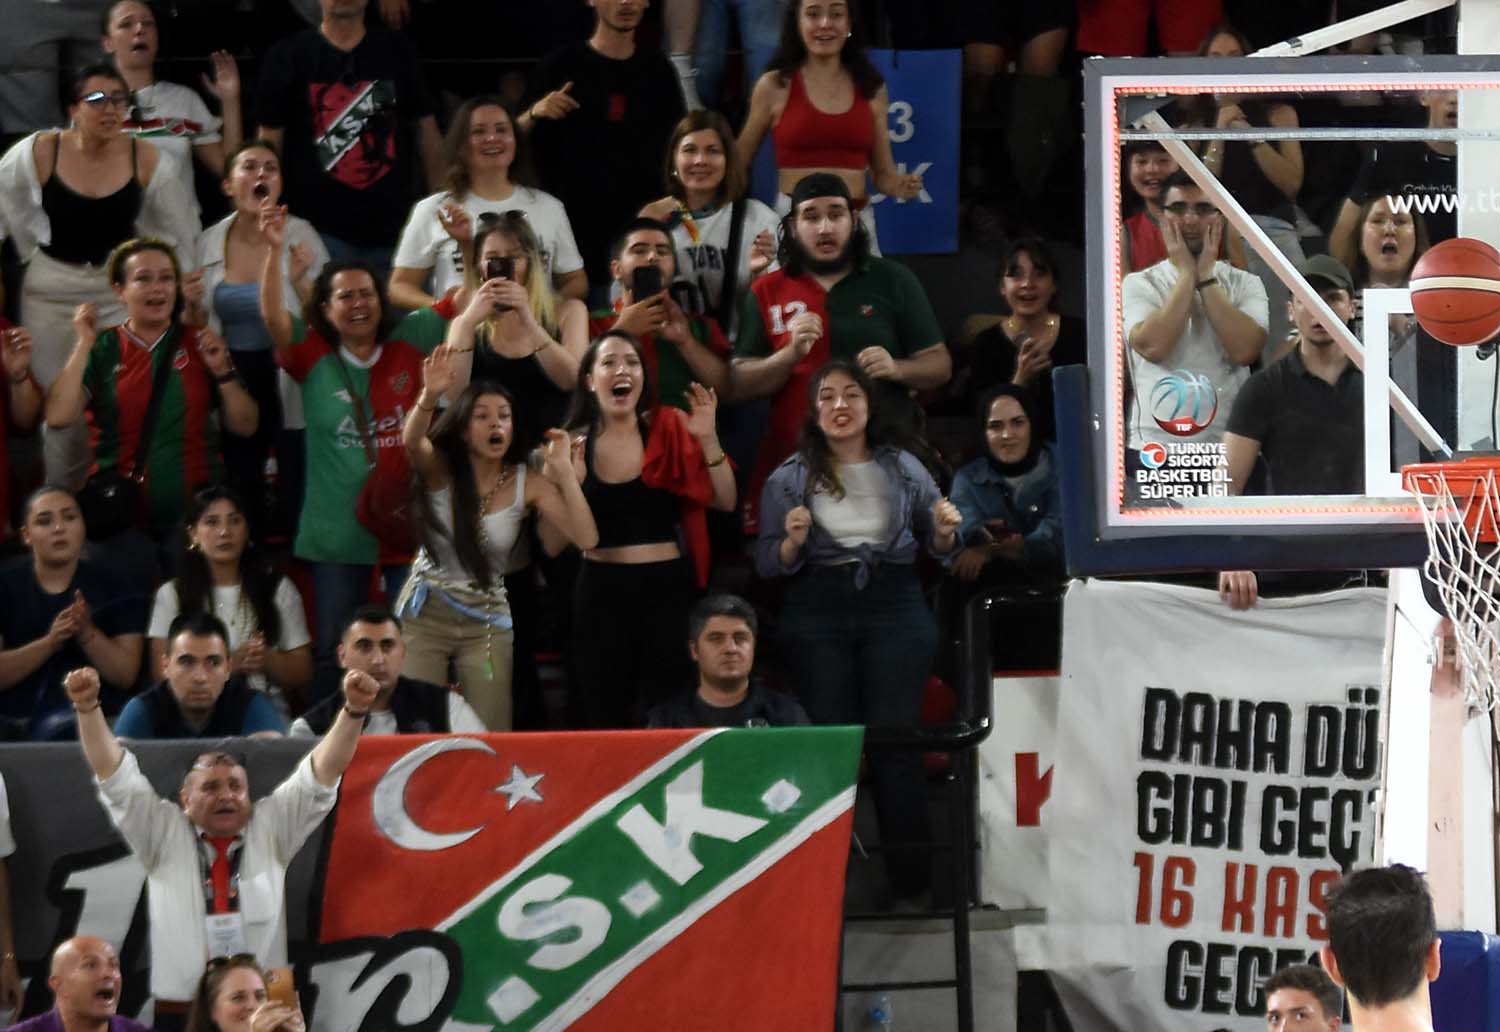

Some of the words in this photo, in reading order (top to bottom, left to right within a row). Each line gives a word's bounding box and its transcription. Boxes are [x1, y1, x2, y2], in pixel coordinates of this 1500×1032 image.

[1175, 422, 1193, 432] TBF
[1136, 468, 1233, 483] BASKETBOL
[1140, 483, 1195, 499] SÜPER
[1140, 686, 1293, 774] DAHA
[1304, 687, 1382, 781] DÜ
[1259, 784, 1381, 875] GEÇ
[1133, 851, 1196, 929] 16
[1221, 860, 1341, 940] KAS
[1164, 939, 1325, 1017] GEC
